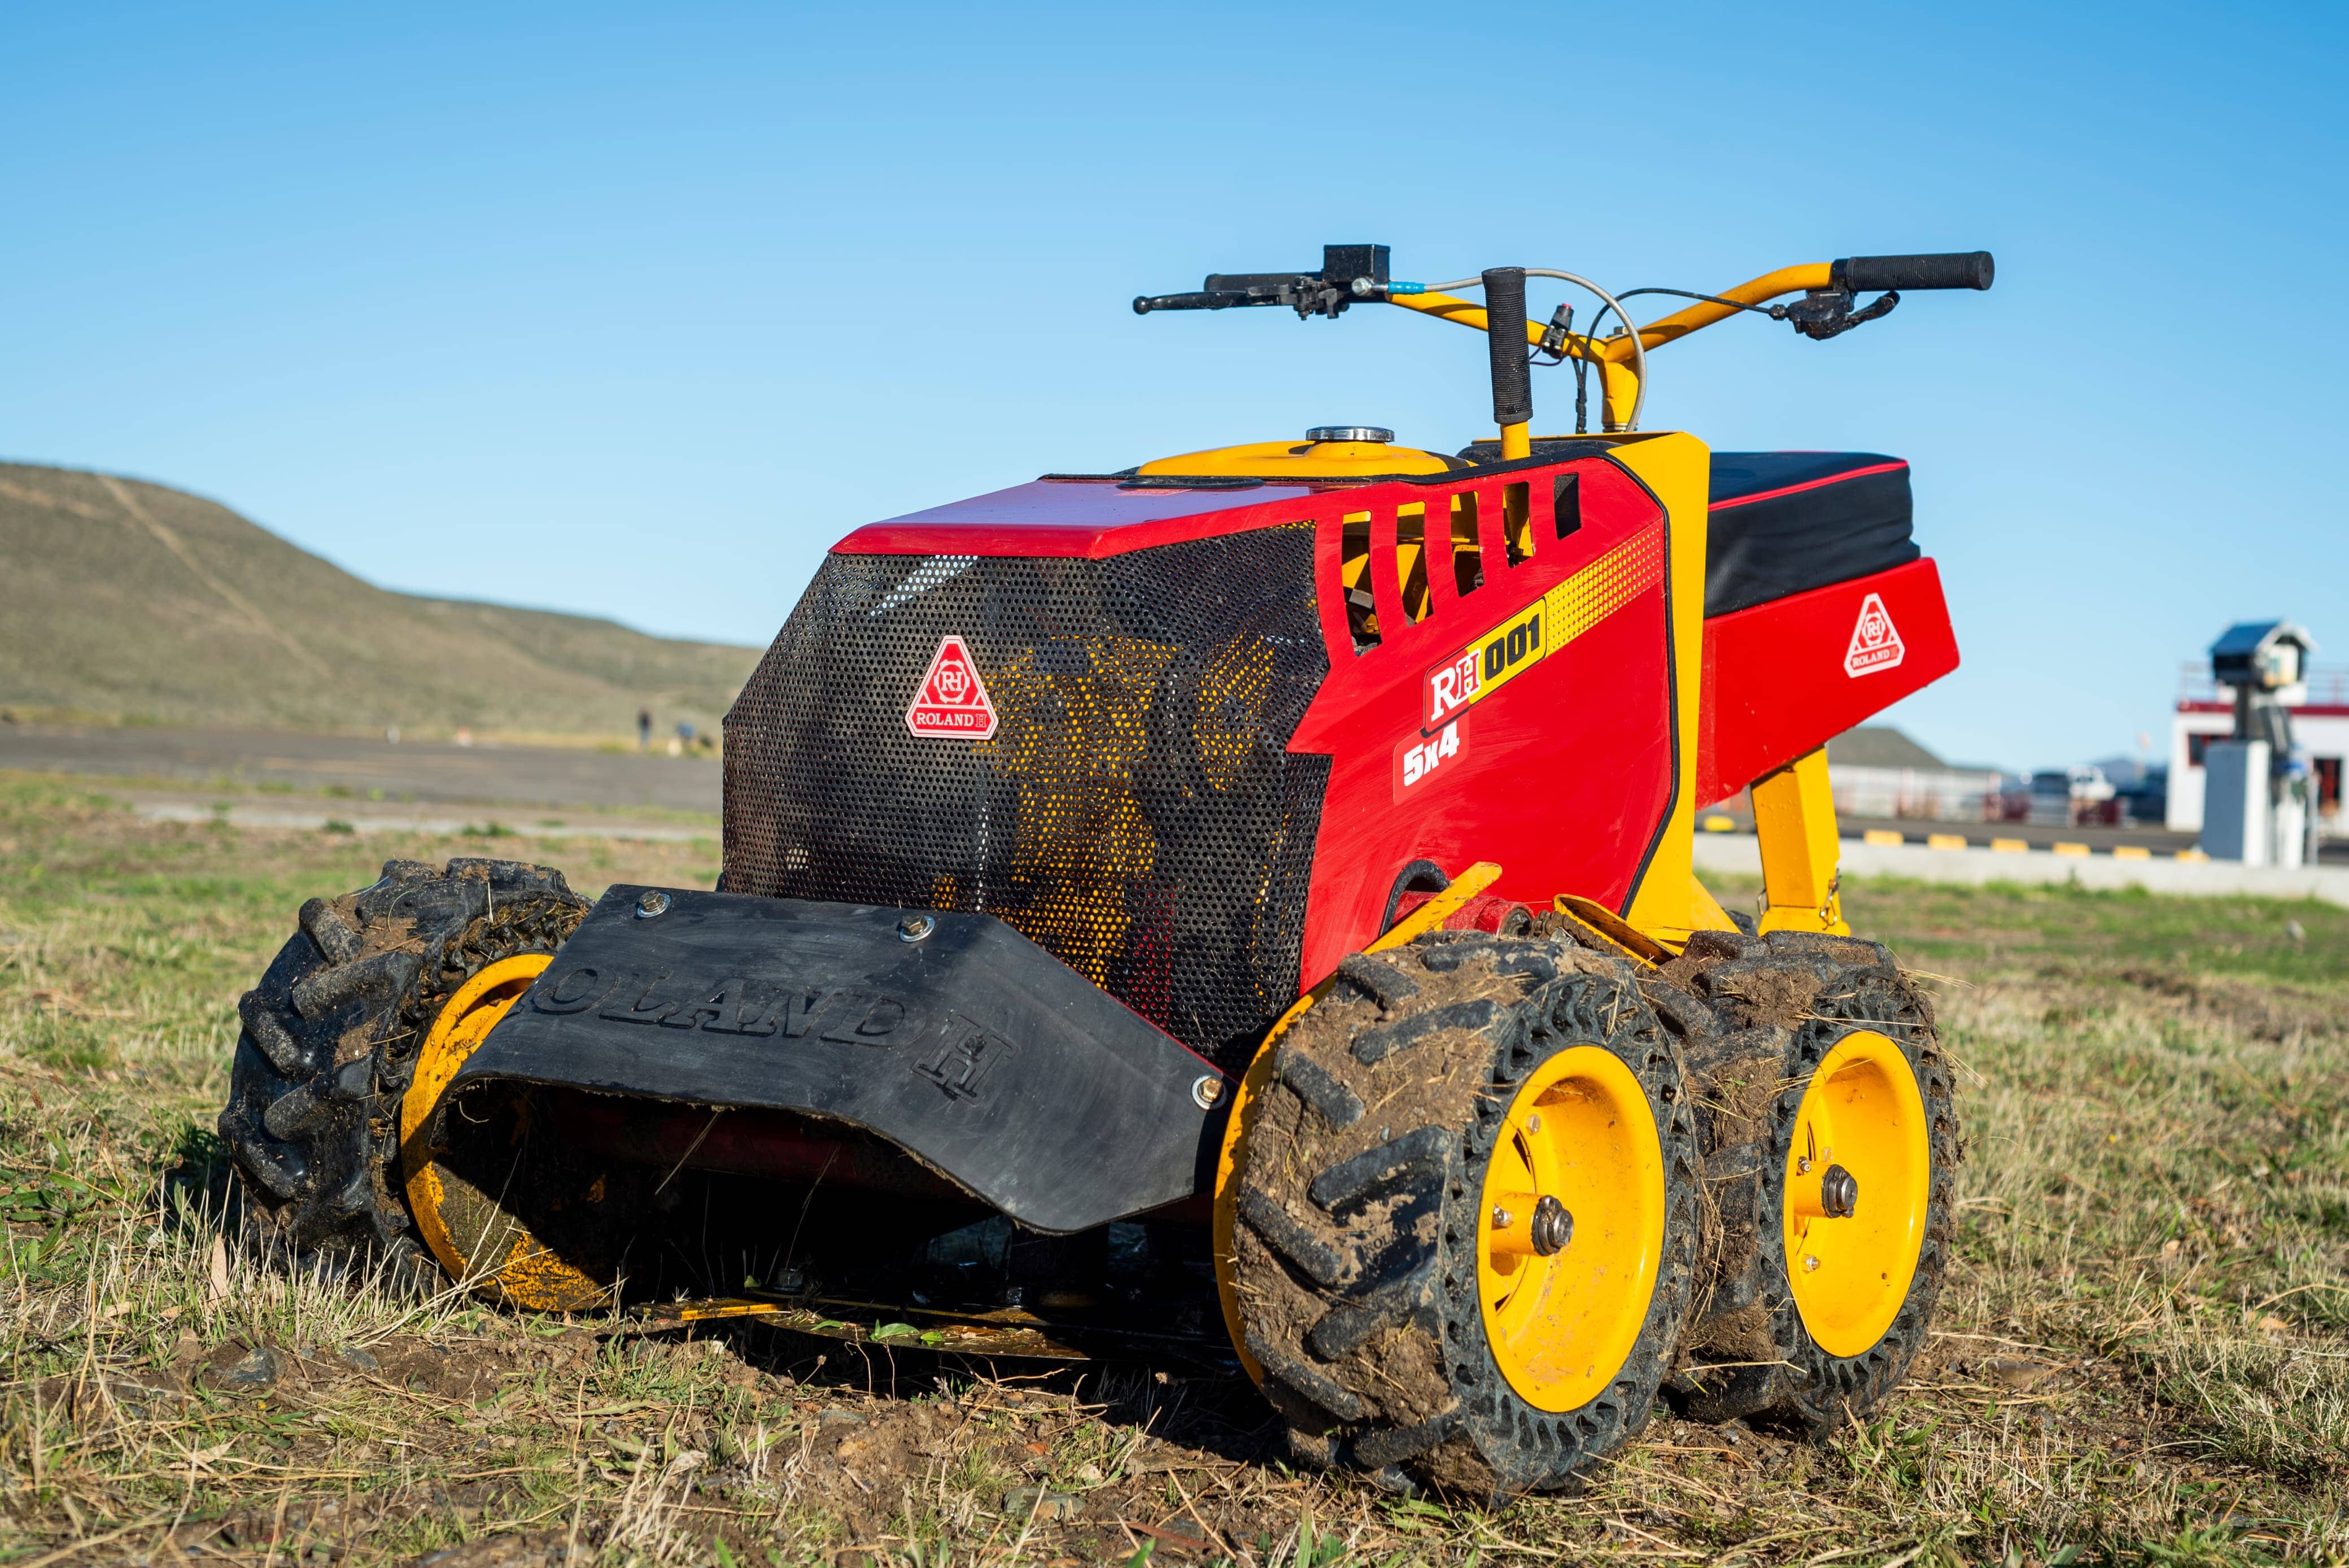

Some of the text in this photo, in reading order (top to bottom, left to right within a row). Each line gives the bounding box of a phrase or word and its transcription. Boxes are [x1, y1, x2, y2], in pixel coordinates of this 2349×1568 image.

[1852, 649, 1890, 668] ROLAND
[916, 712, 974, 727] ROLAND
[1403, 720, 1460, 787] 5x4
[504, 965, 928, 1049] OLAND
